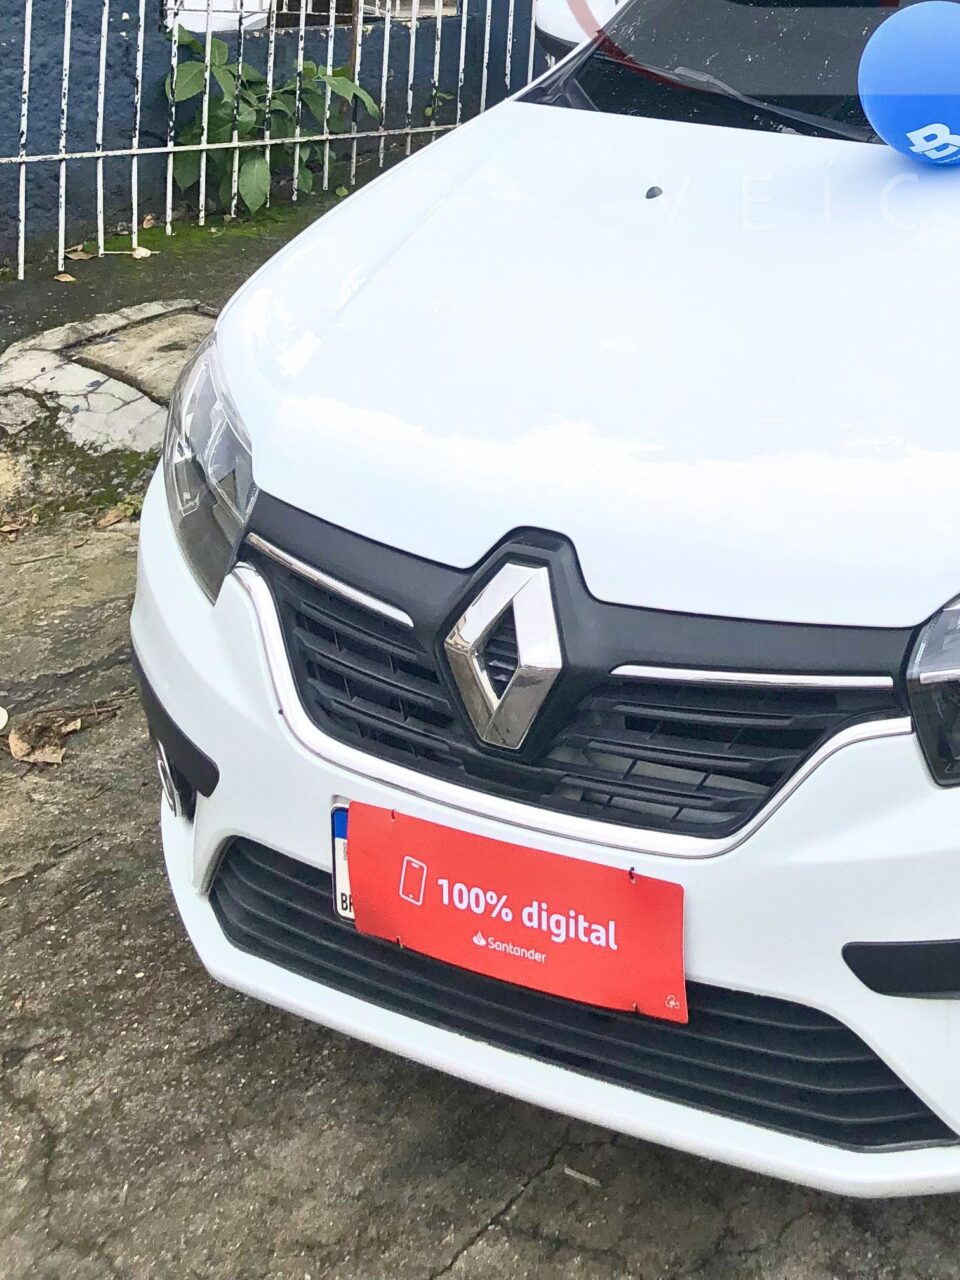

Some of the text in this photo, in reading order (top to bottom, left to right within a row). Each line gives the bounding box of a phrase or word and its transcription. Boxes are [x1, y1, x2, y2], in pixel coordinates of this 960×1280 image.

[437, 878, 618, 951] 100% digital
[487, 935, 547, 964] Santander
